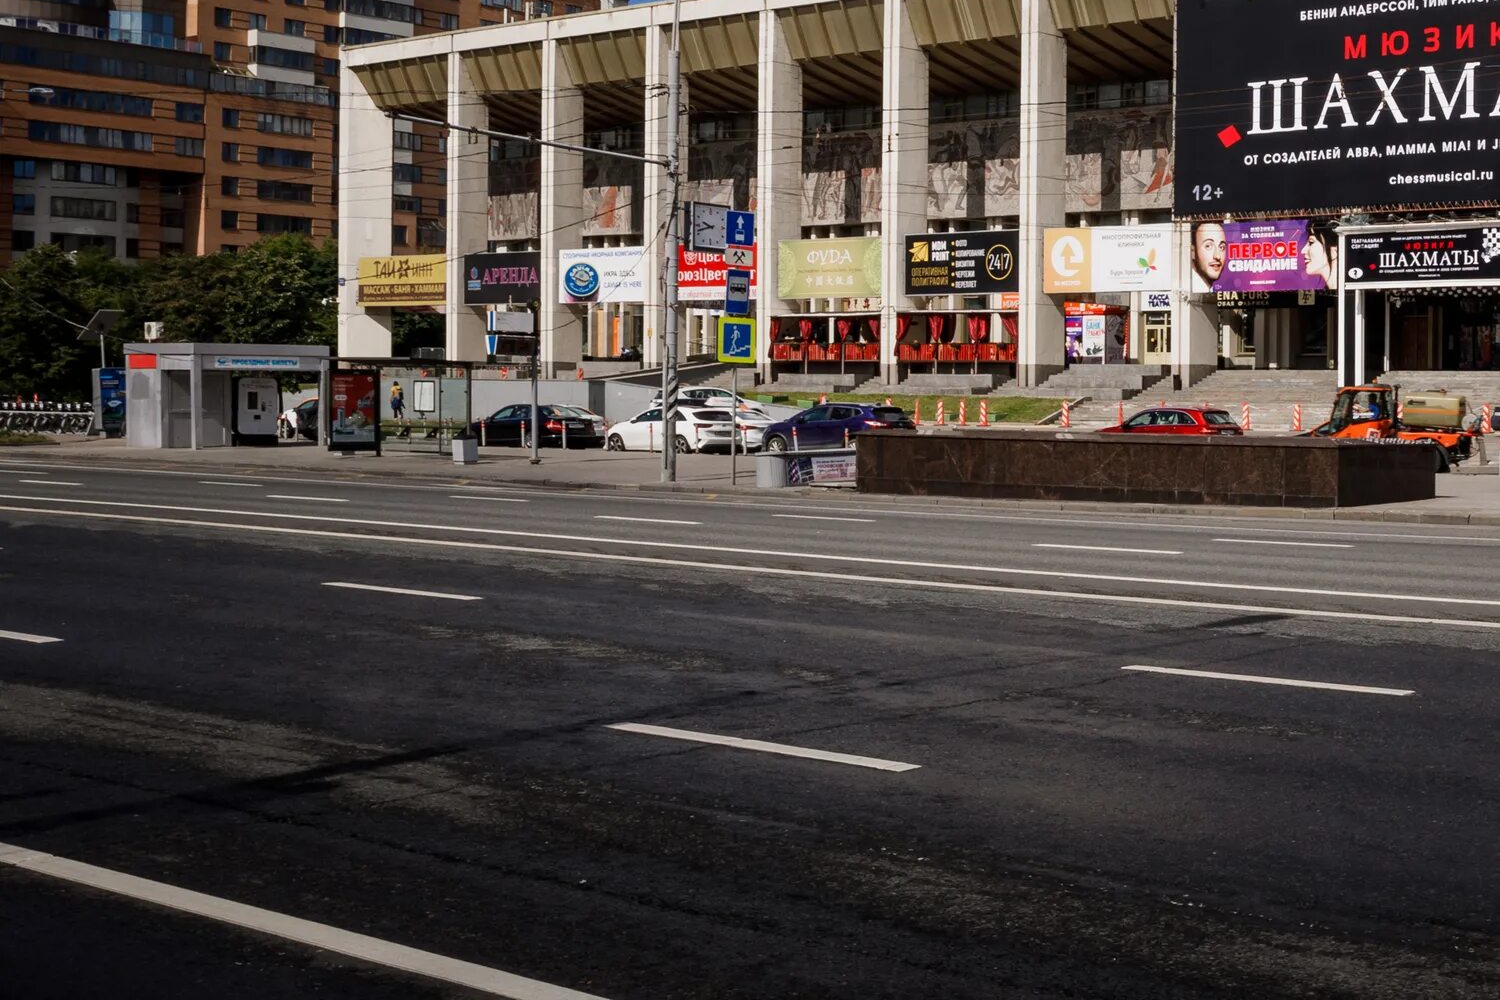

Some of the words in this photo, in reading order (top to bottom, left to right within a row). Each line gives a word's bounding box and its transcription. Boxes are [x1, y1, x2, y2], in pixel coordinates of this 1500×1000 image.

[1299, 7, 1338, 21] БЕННИ
[1339, 0, 1419, 17] АНДЕРССОН,
[1243, 154, 1259, 166] ОТ
[1263, 147, 1341, 165] СОЗДАТЕЛЕЙ
[1441, 140, 1471, 152] MIA!
[1477, 139, 1487, 151] И
[1388, 169, 1494, 186] chessmusical.ru
[1192, 184, 1224, 201] 12+
[1228, 240, 1298, 260] ПЕРВОЕ
[1378, 249, 1480, 268] ШАХМАТЫ
[374, 258, 396, 280] ТАЙ
[1228, 257, 1298, 273] СВИДАНИЕ
[482, 267, 539, 287] АРЕНДА
[1217, 291, 1239, 300] ENA
